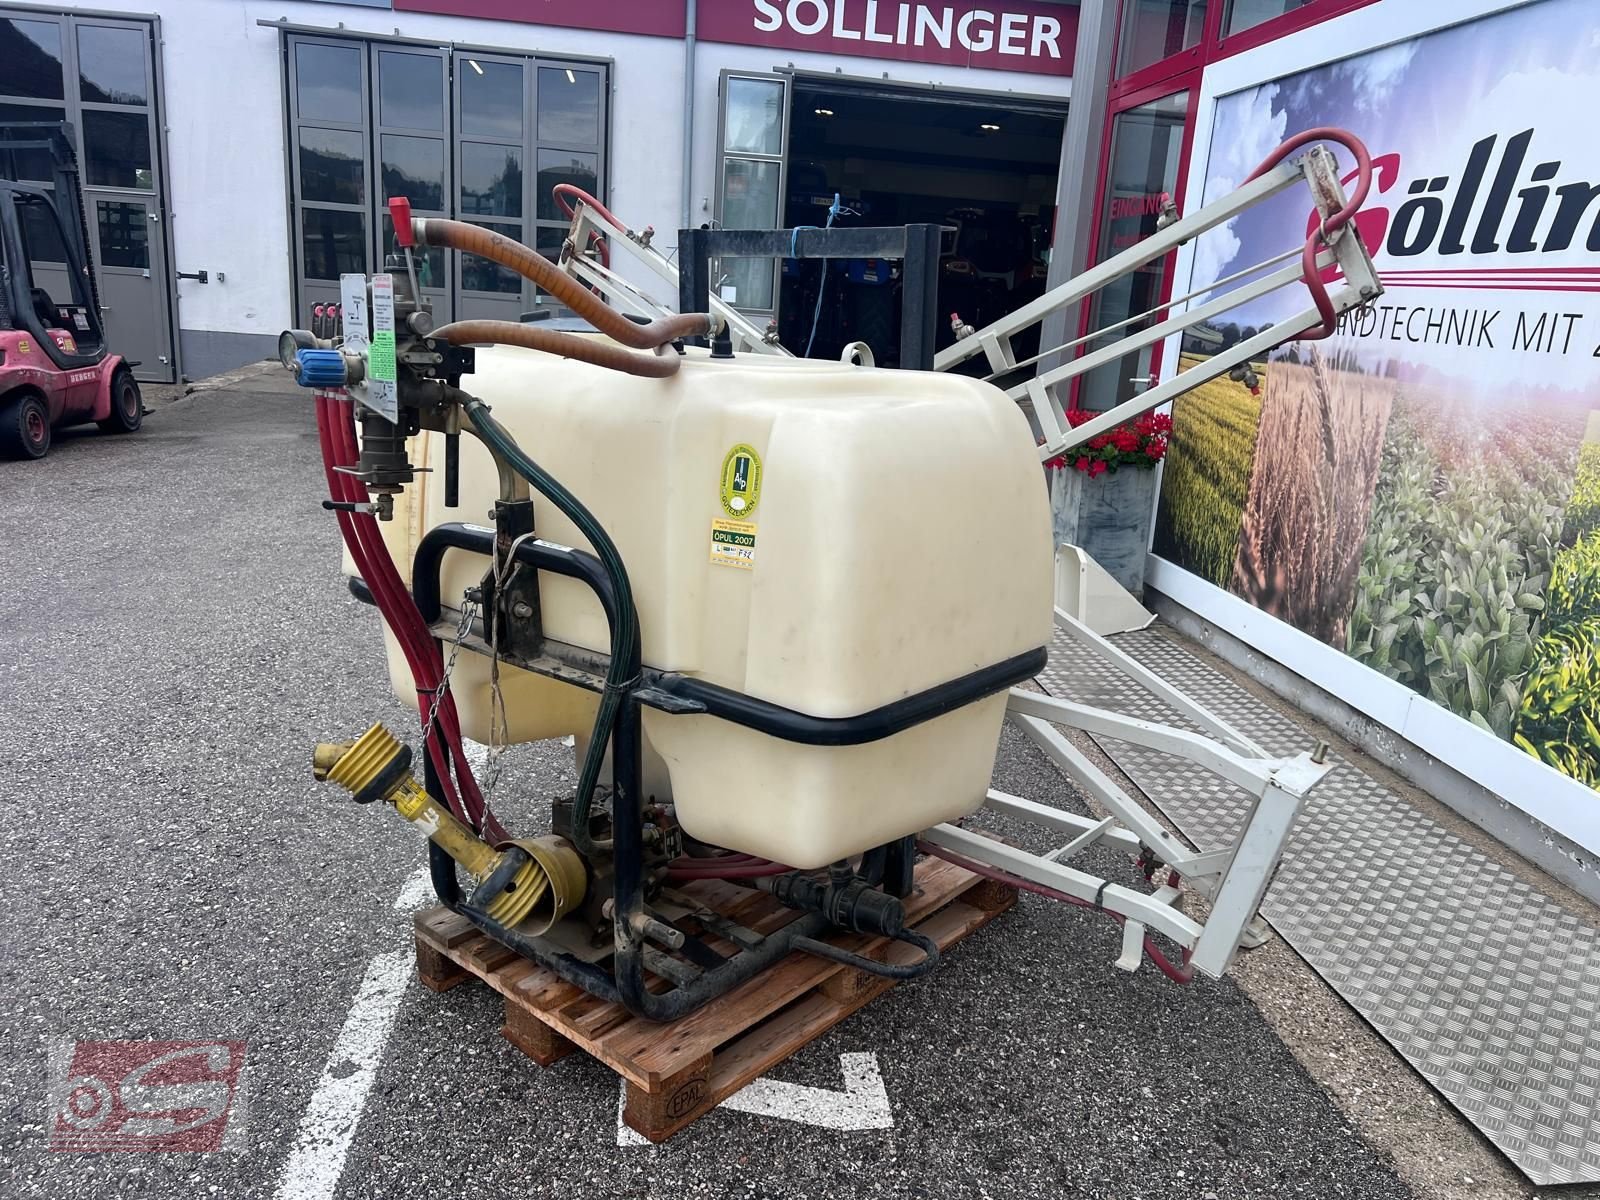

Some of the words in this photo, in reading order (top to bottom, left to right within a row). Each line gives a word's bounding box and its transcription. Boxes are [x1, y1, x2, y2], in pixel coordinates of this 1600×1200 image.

[1512, 311, 1584, 354] MIT
[734, 535, 754, 546] 2007
[673, 1085, 706, 1114] EPAL
